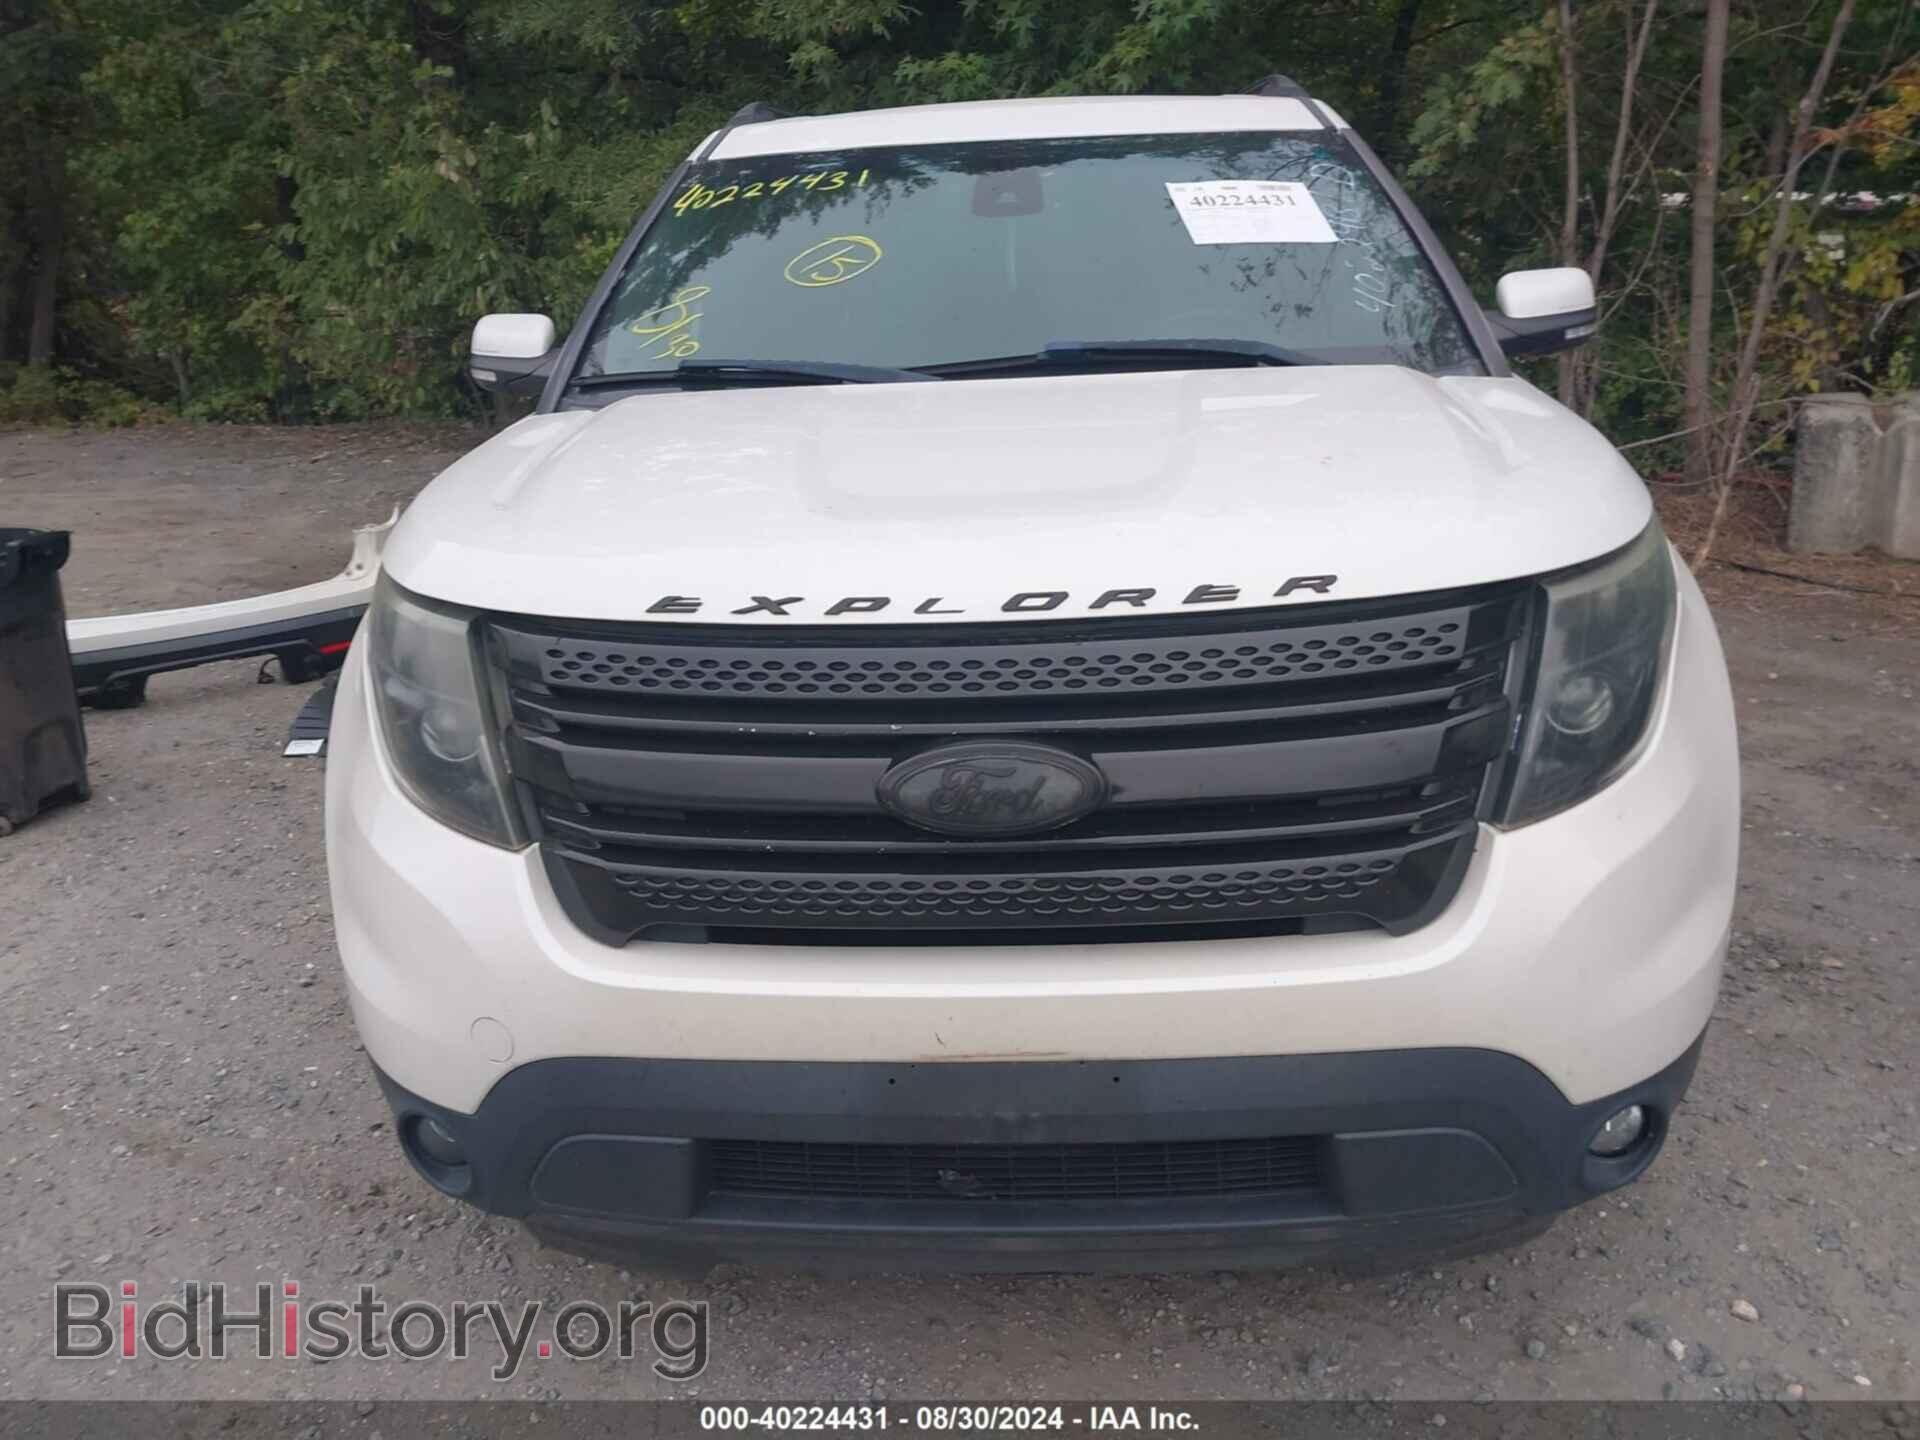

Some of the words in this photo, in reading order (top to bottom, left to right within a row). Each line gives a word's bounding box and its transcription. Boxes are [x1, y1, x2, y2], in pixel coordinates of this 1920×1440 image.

[673, 168, 870, 217] 40224431
[1190, 194, 1297, 207] 40224431
[645, 574, 1338, 615] EXPLORER
[929, 766, 1047, 815] Ford
